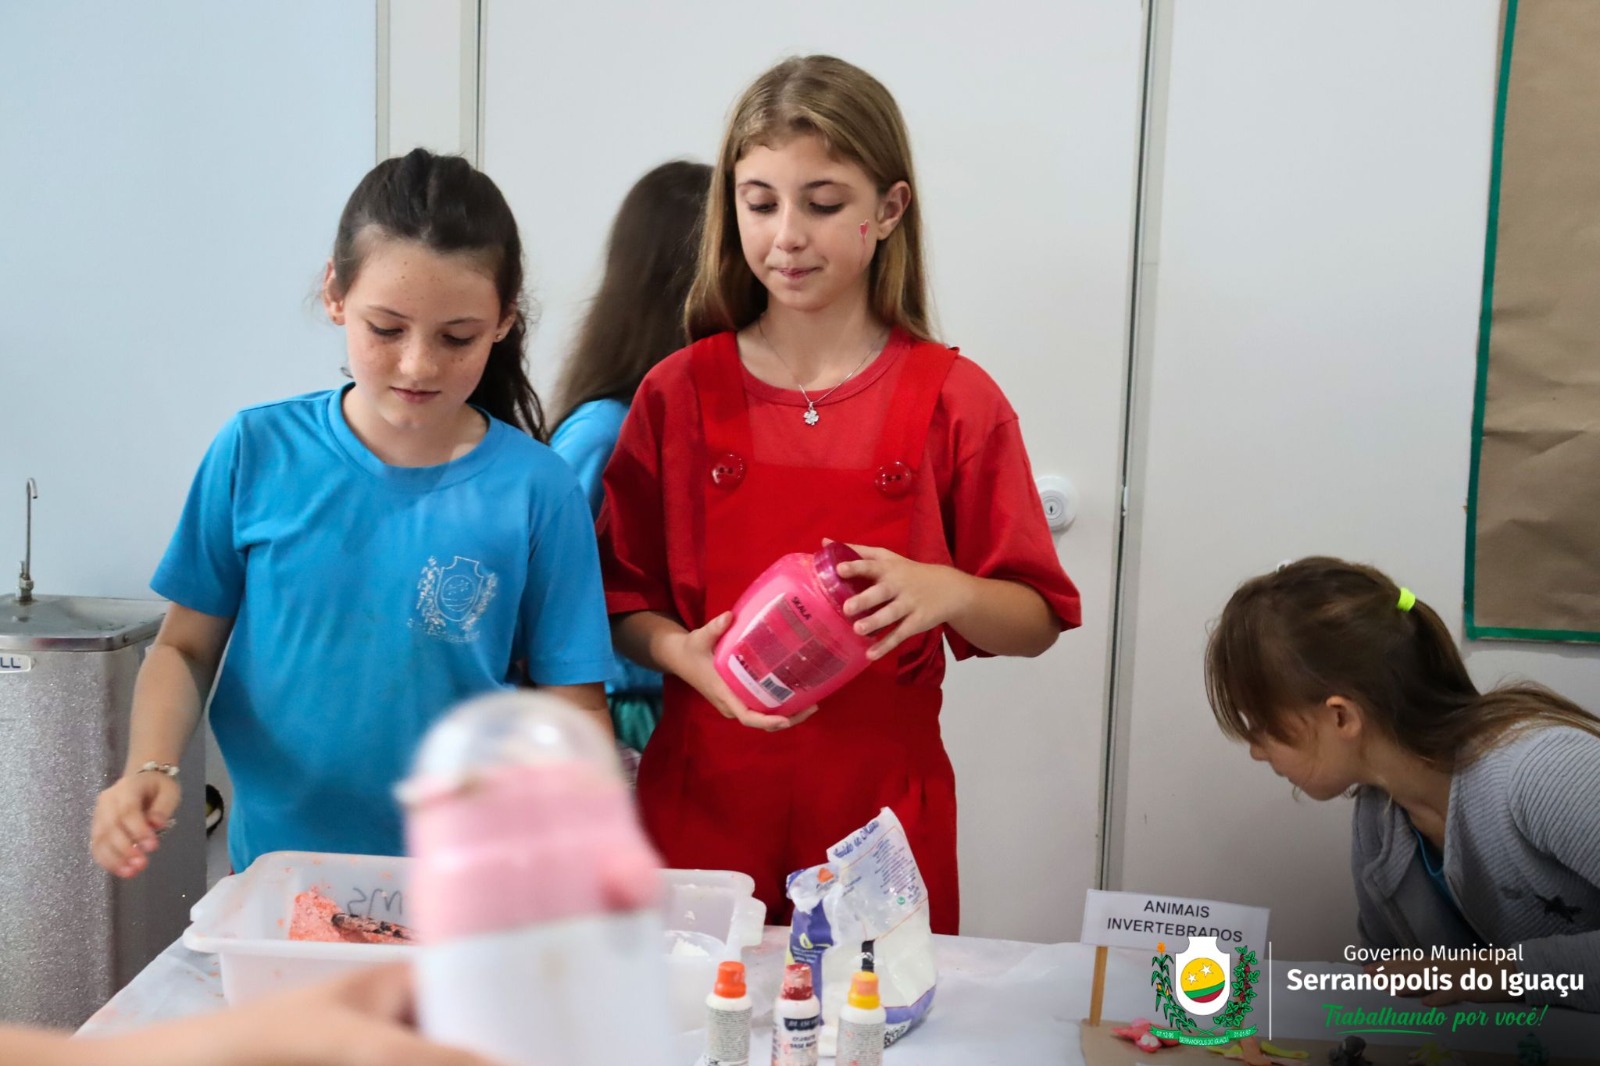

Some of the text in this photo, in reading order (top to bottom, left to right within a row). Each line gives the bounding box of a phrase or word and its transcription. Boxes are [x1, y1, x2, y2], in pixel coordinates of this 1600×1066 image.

[791, 596, 812, 621] SKALA
[1144, 900, 1210, 918] ANIMAIS
[1107, 917, 1243, 942] INVERTEBRADOS
